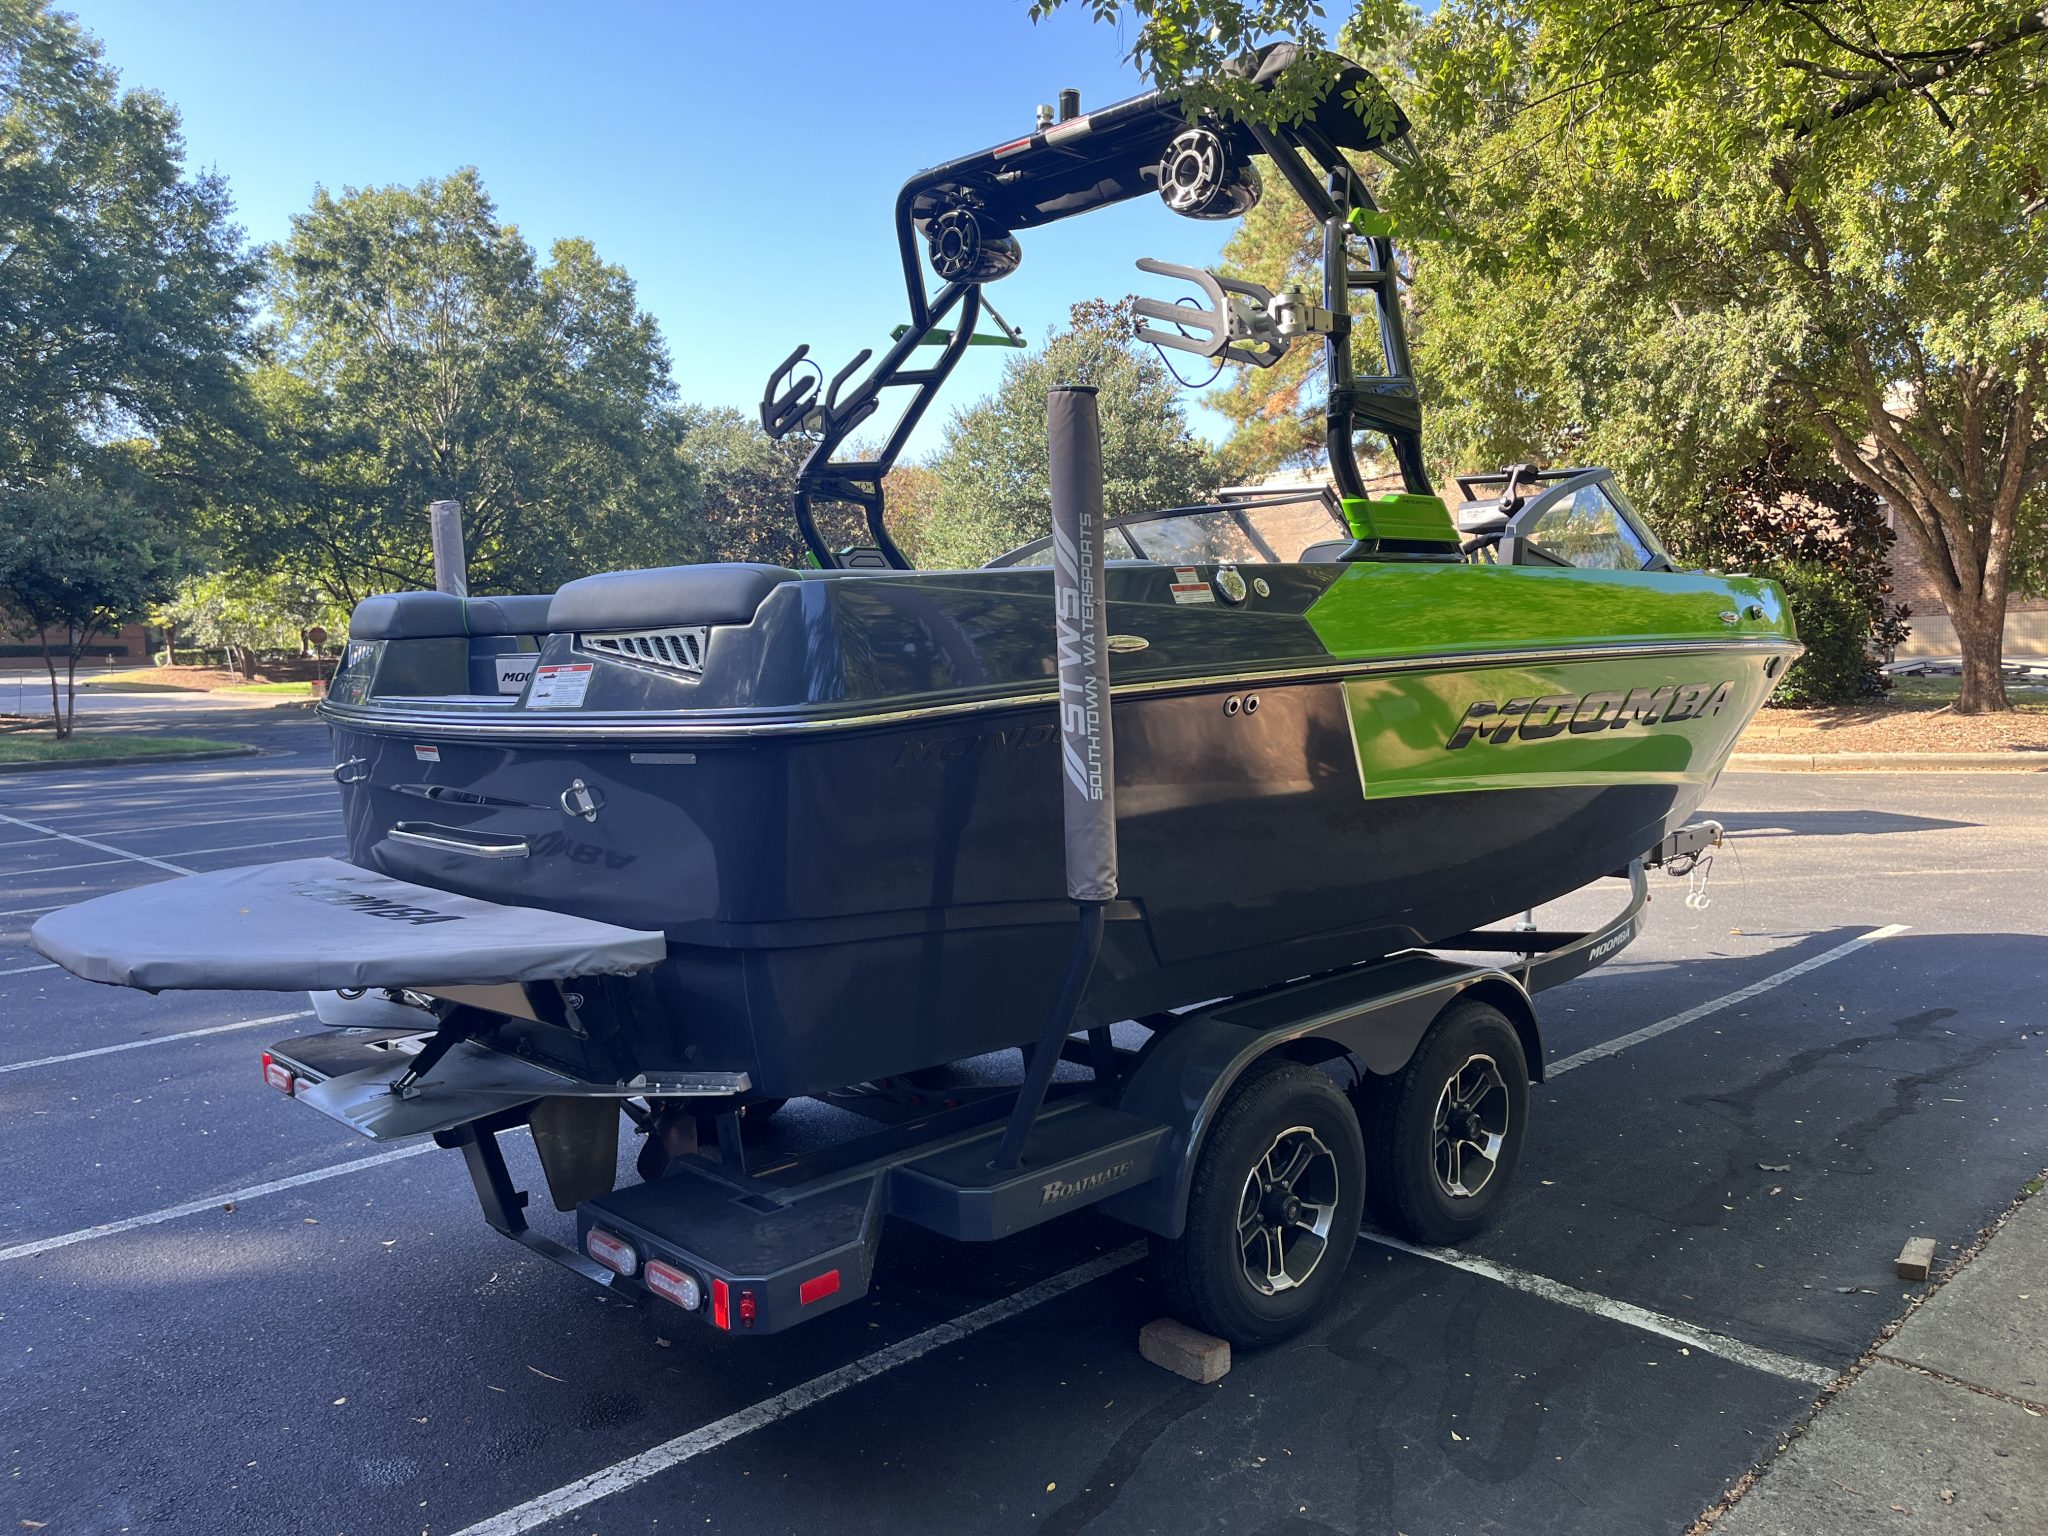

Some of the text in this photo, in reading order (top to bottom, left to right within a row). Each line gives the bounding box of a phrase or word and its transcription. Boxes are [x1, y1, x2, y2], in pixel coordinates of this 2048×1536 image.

[1055, 585, 1086, 736] STWS
[1080, 512, 1103, 801] SOUTHTOWN WATERSPORTS
[1446, 680, 1736, 750] MOOMBA
[892, 723, 1062, 768] MOND
[1589, 927, 1631, 961] MOOMBA
[1040, 1162, 1131, 1206] BOATMATE
